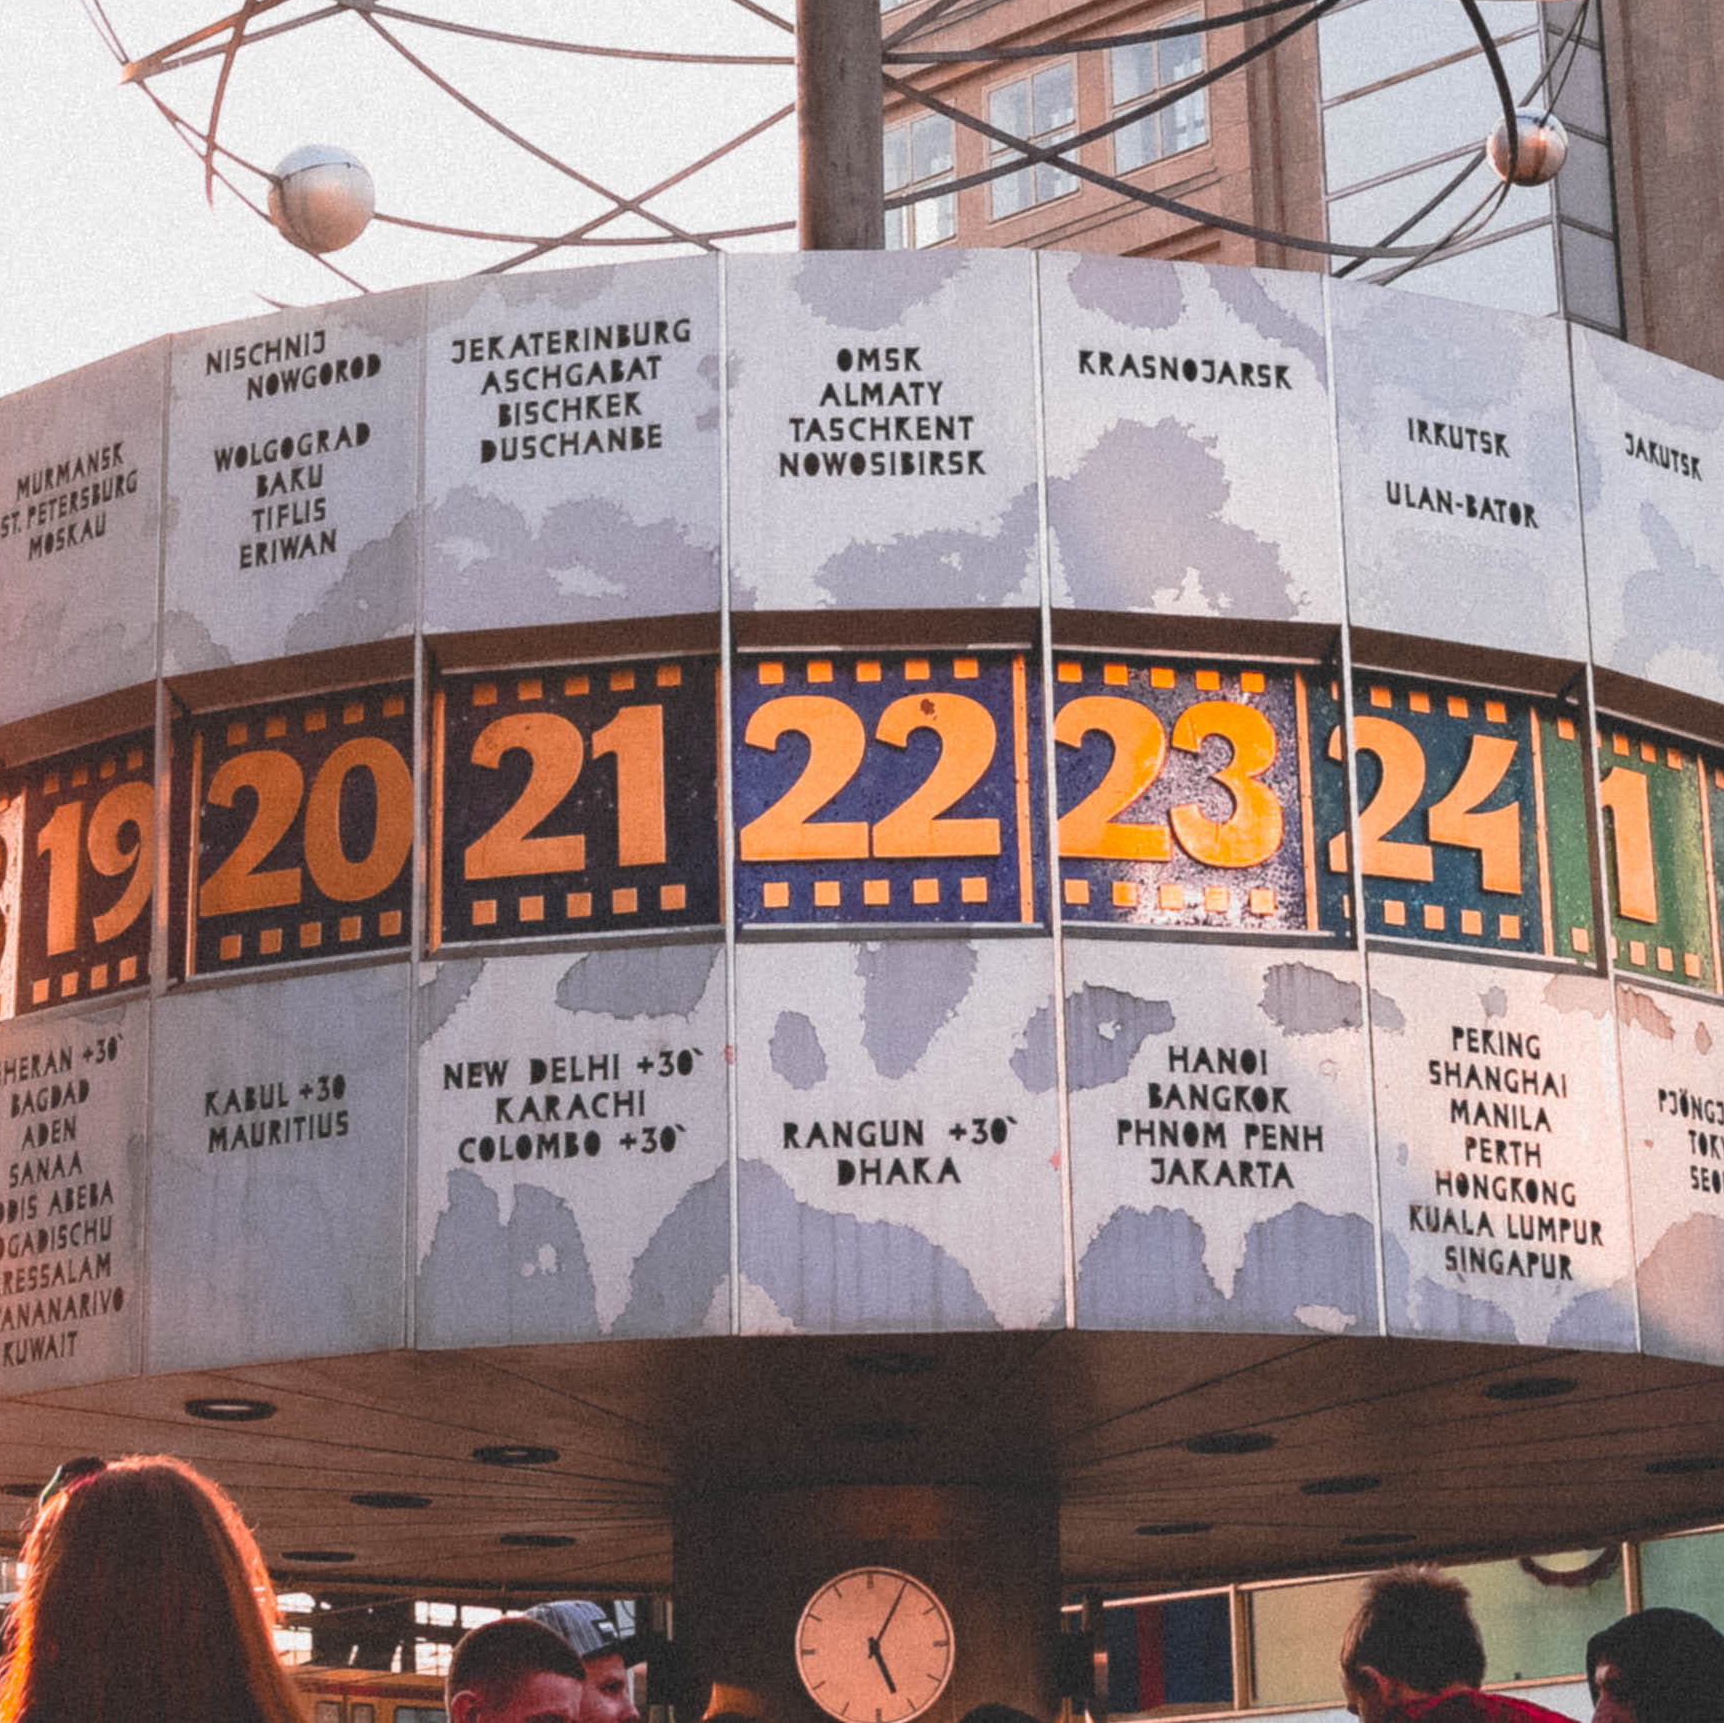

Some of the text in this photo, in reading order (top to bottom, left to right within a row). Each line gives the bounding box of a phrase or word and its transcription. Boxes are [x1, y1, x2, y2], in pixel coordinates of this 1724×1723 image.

[206, 330, 325, 376] NISCHNIJ
[451, 318, 690, 363] JEKATERINBURG
[837, 347, 922, 372] OMSK
[247, 353, 381, 400] NOWGOROD
[480, 355, 662, 395] ASCHGABAT
[1078, 350, 1292, 390] KRASNOJARSK
[498, 392, 642, 427] BISCHKEK
[819, 381, 942, 406] ALMATY
[214, 422, 370, 473] WOLGOGRAD
[480, 424, 662, 463] DUSCHANBE
[789, 416, 974, 442] TASCHKENT
[1408, 418, 1510, 458] IRKUTSK
[17, 441, 124, 500] MURMANSK
[780, 451, 986, 476] NOWOSIBIRSK
[1625, 433, 1702, 481] JAKUTSK
[256, 464, 324, 499] BAKU
[1, 469, 137, 538] ST. PETERSBURG
[252, 498, 326, 532] TIFLIS
[1386, 481, 1538, 528] ULAN-BATOR
[29, 512, 106, 560] MOSKAU
[239, 529, 337, 570] ERIWAN
[465, 704, 667, 879] 21
[740, 694, 1000, 863] 22
[1054, 696, 1284, 871] 23
[1329, 715, 1520, 896] 24
[199, 735, 413, 918] 20
[1600, 766, 1658, 924] 1
[37, 781, 155, 957] 19
[1168, 1046, 1268, 1076] HANOI
[1452, 1026, 1541, 1059] PEKING
[444, 1059, 509, 1090] NEW
[529, 1053, 620, 1086] DELHI
[1429, 1060, 1567, 1098] SHANGHAI
[10, 1078, 90, 1118] BAGDAD
[205, 1074, 346, 1117] KABUL +30
[495, 1089, 645, 1124] KARACHI
[1148, 1083, 1290, 1114] BANGKOK
[21, 1115, 78, 1150] ADEN
[208, 1109, 349, 1153] MAURITIUS
[783, 1120, 924, 1149] RANGUN
[1450, 1099, 1552, 1133] MANILA
[458, 1130, 601, 1164] COLOMBO
[1117, 1119, 1324, 1153] PHNOM PENH
[1465, 1137, 1542, 1168] PERTH
[8, 1150, 83, 1189] SANAA
[837, 1157, 961, 1185] DHAKA
[1151, 1158, 1294, 1189] JAKARTA
[1435, 1170, 1577, 1207] HONGKONG
[48, 1179, 114, 1216] ABEBA
[1409, 1204, 1604, 1247] KUALA LUMPUR
[1445, 1245, 1573, 1281] SINGAPUR
[2, 1331, 78, 1368] KUWAIT
